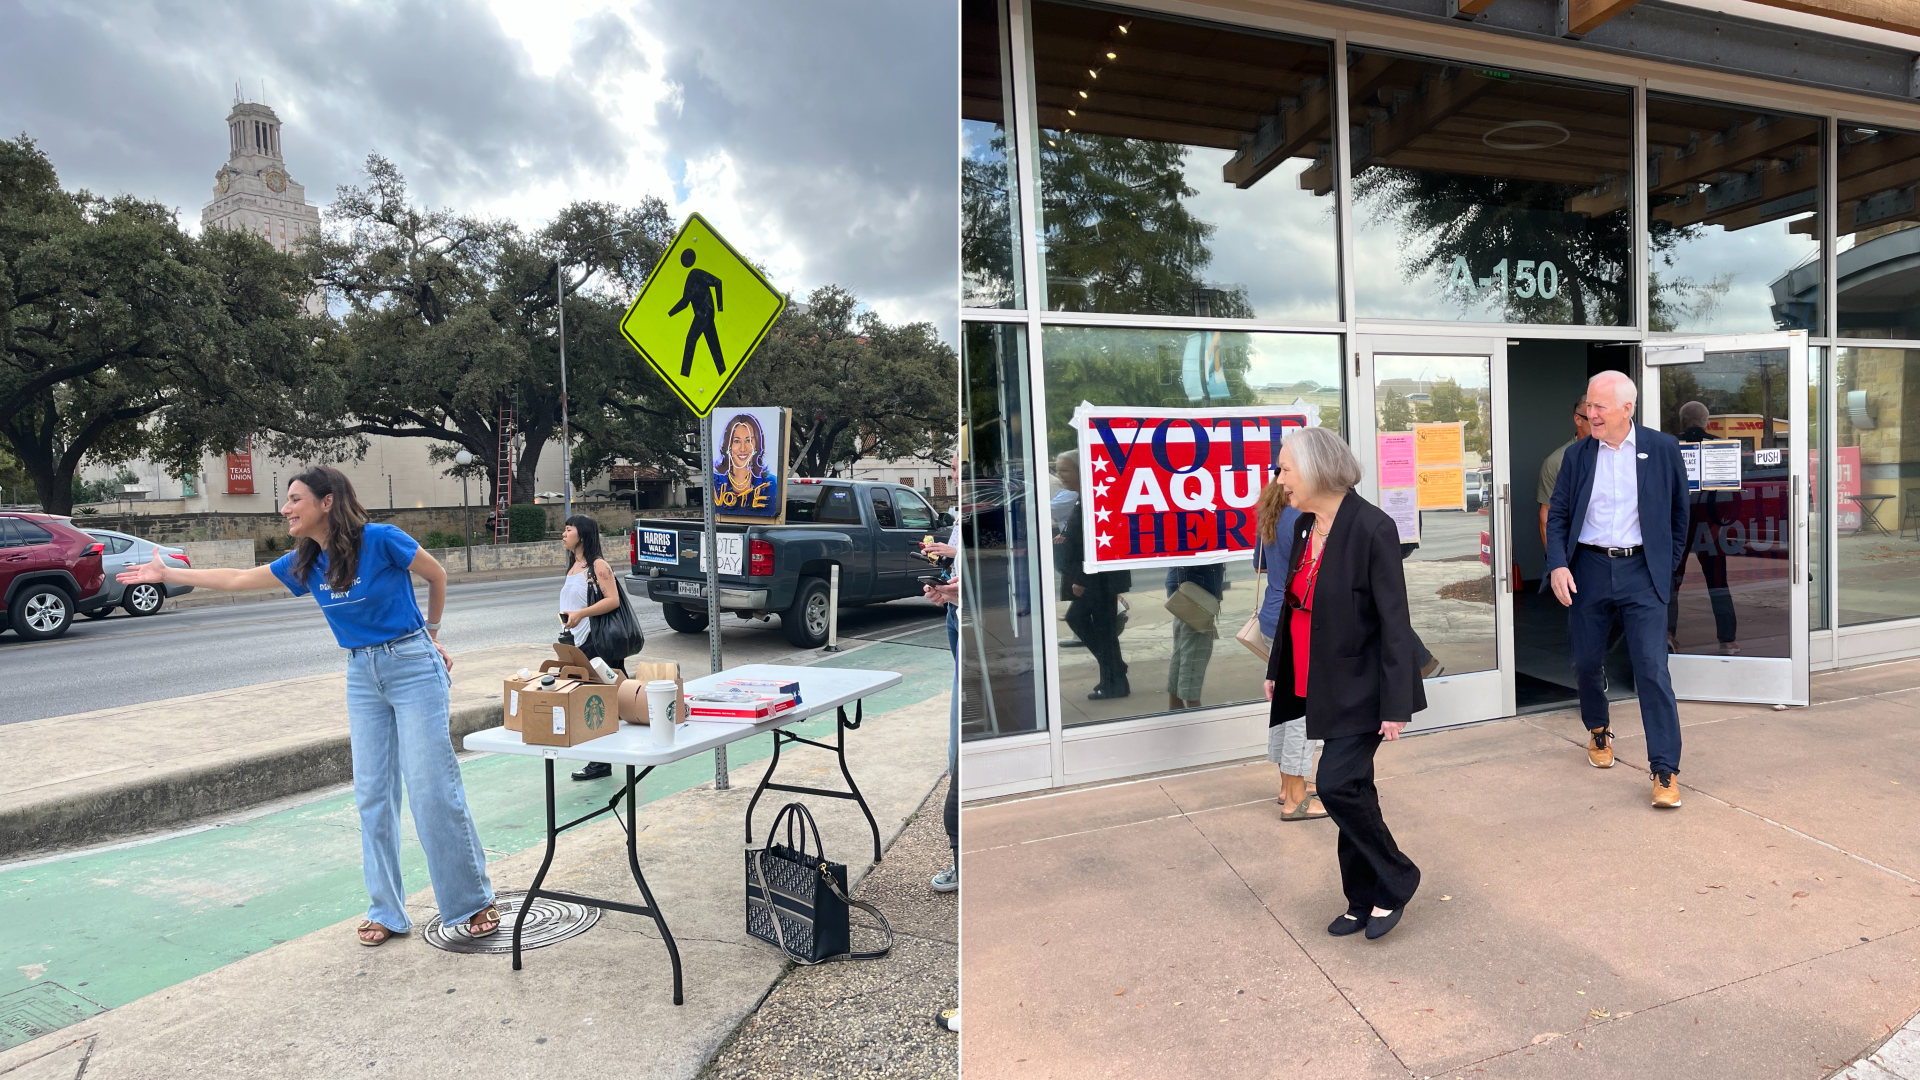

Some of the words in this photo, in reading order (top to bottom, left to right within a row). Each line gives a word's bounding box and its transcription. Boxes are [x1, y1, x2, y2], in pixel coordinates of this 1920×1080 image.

[1445, 256, 1558, 299] A-150
[1757, 451, 1779, 463] PUSH
[713, 481, 771, 508] VOTE
[1121, 464, 1274, 513] AQU
[644, 532, 671, 546] HARRIS
[1125, 509, 1256, 555] HER
[648, 545, 667, 553] WALZ
[716, 537, 738, 555] OTE
